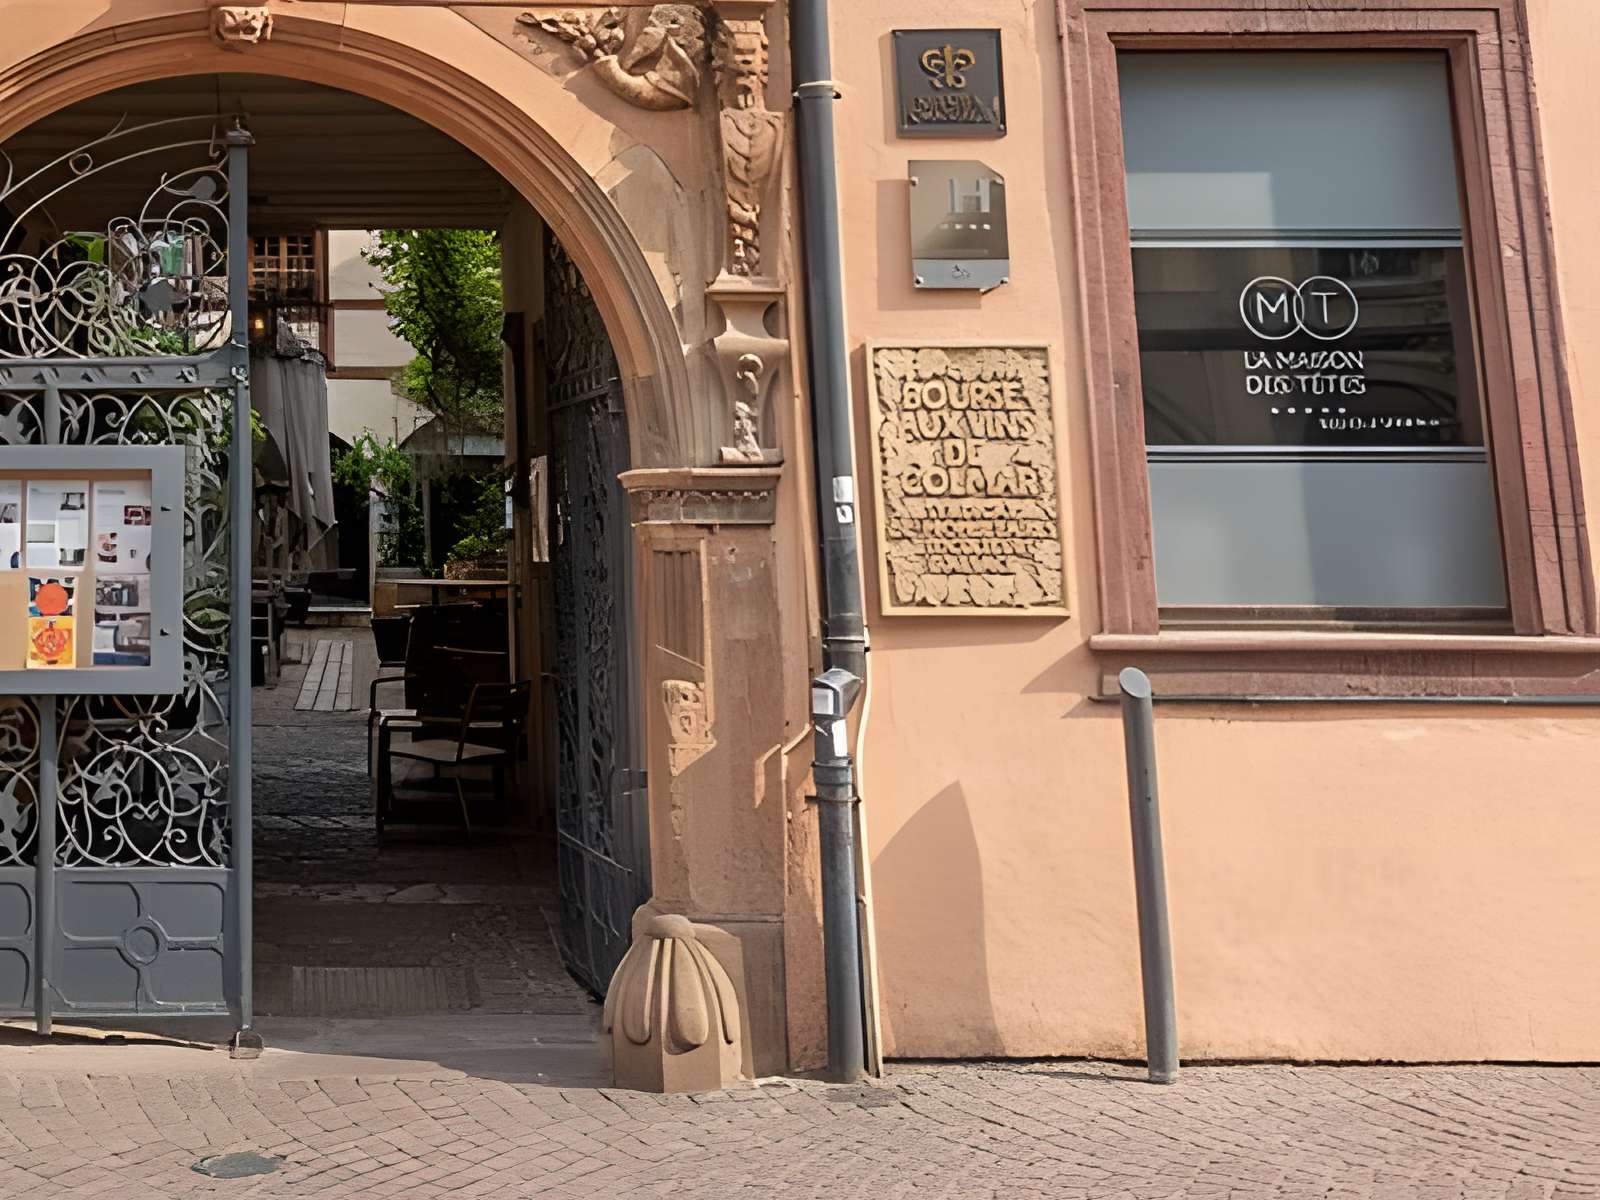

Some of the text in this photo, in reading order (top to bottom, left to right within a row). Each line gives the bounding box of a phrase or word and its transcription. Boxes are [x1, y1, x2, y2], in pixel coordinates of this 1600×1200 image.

[902, 379, 1030, 409] BOURSE
[901, 409, 1037, 441] AUX VINS
